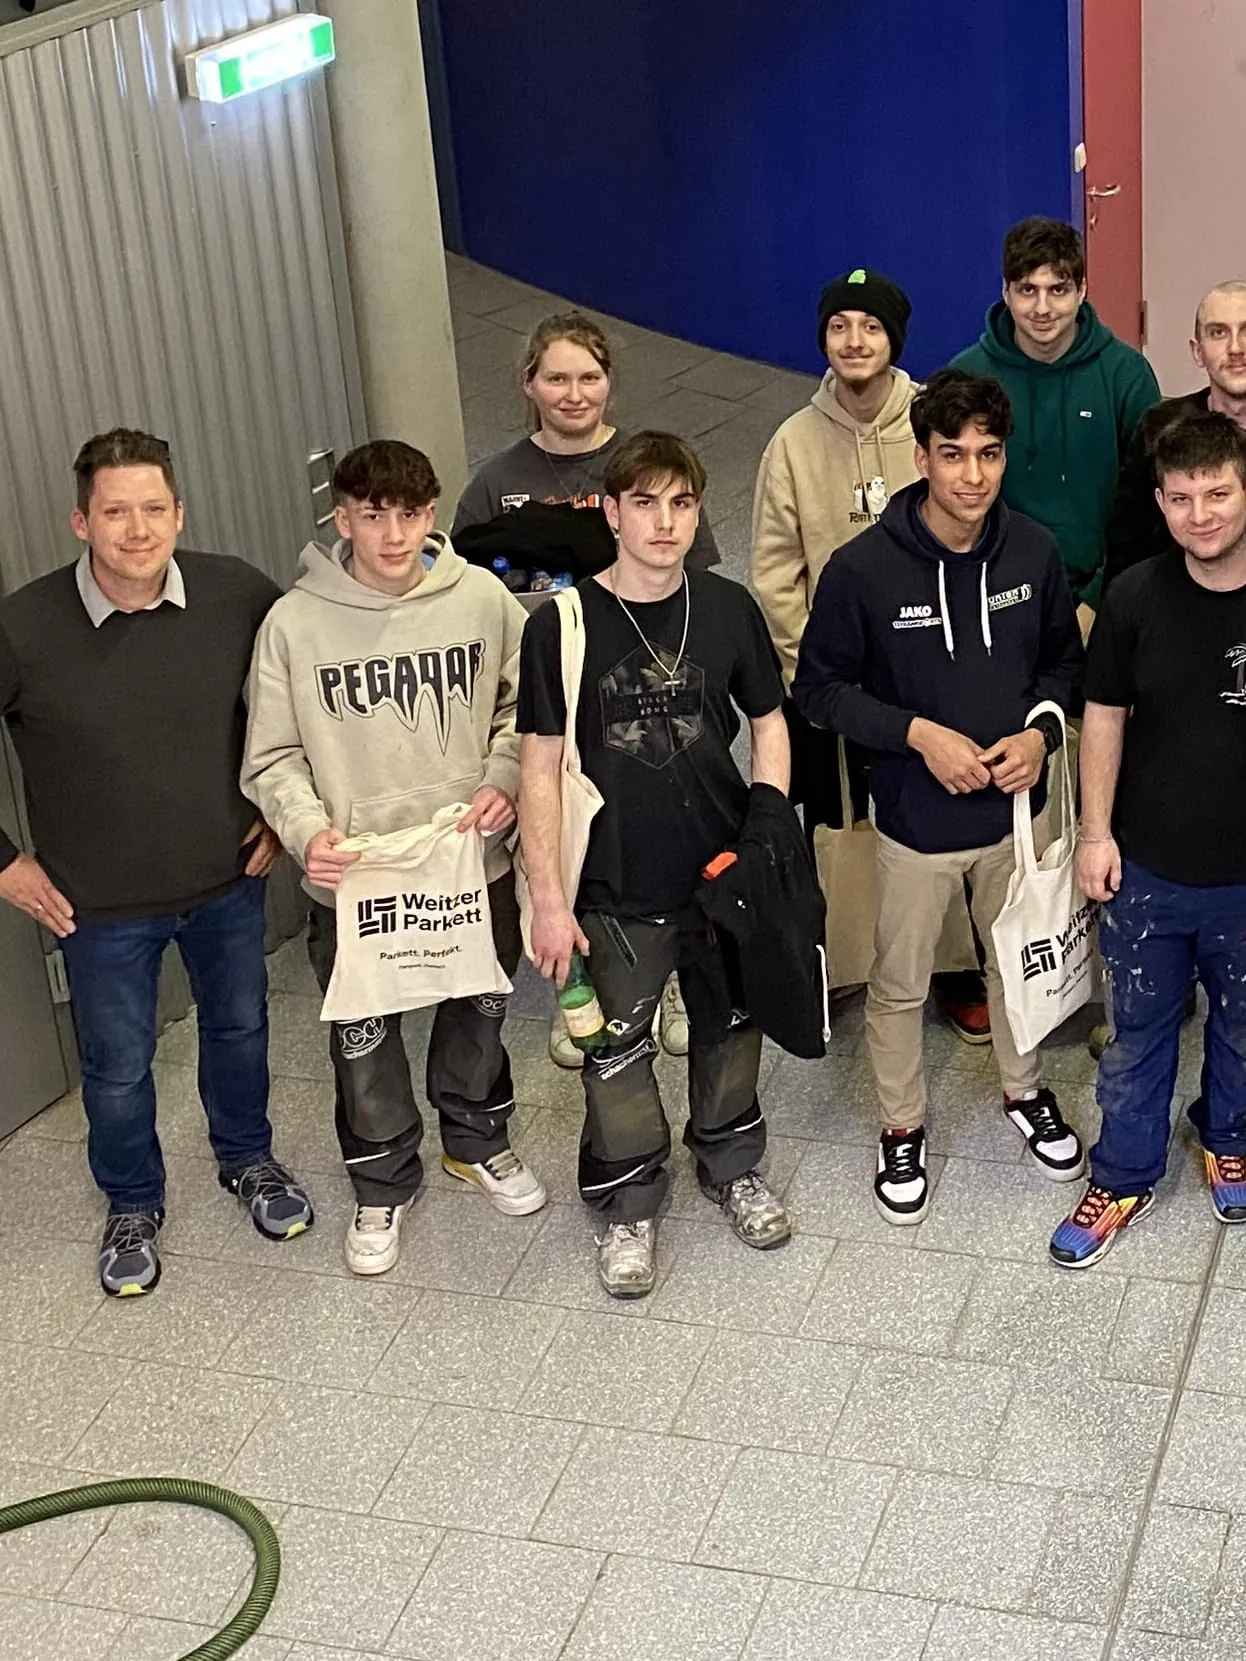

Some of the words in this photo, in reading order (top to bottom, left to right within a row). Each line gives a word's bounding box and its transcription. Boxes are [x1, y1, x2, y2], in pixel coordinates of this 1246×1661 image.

[899, 605, 932, 619] JAKO
[401, 888, 482, 912] Weitzer
[403, 907, 483, 932] Parkett
